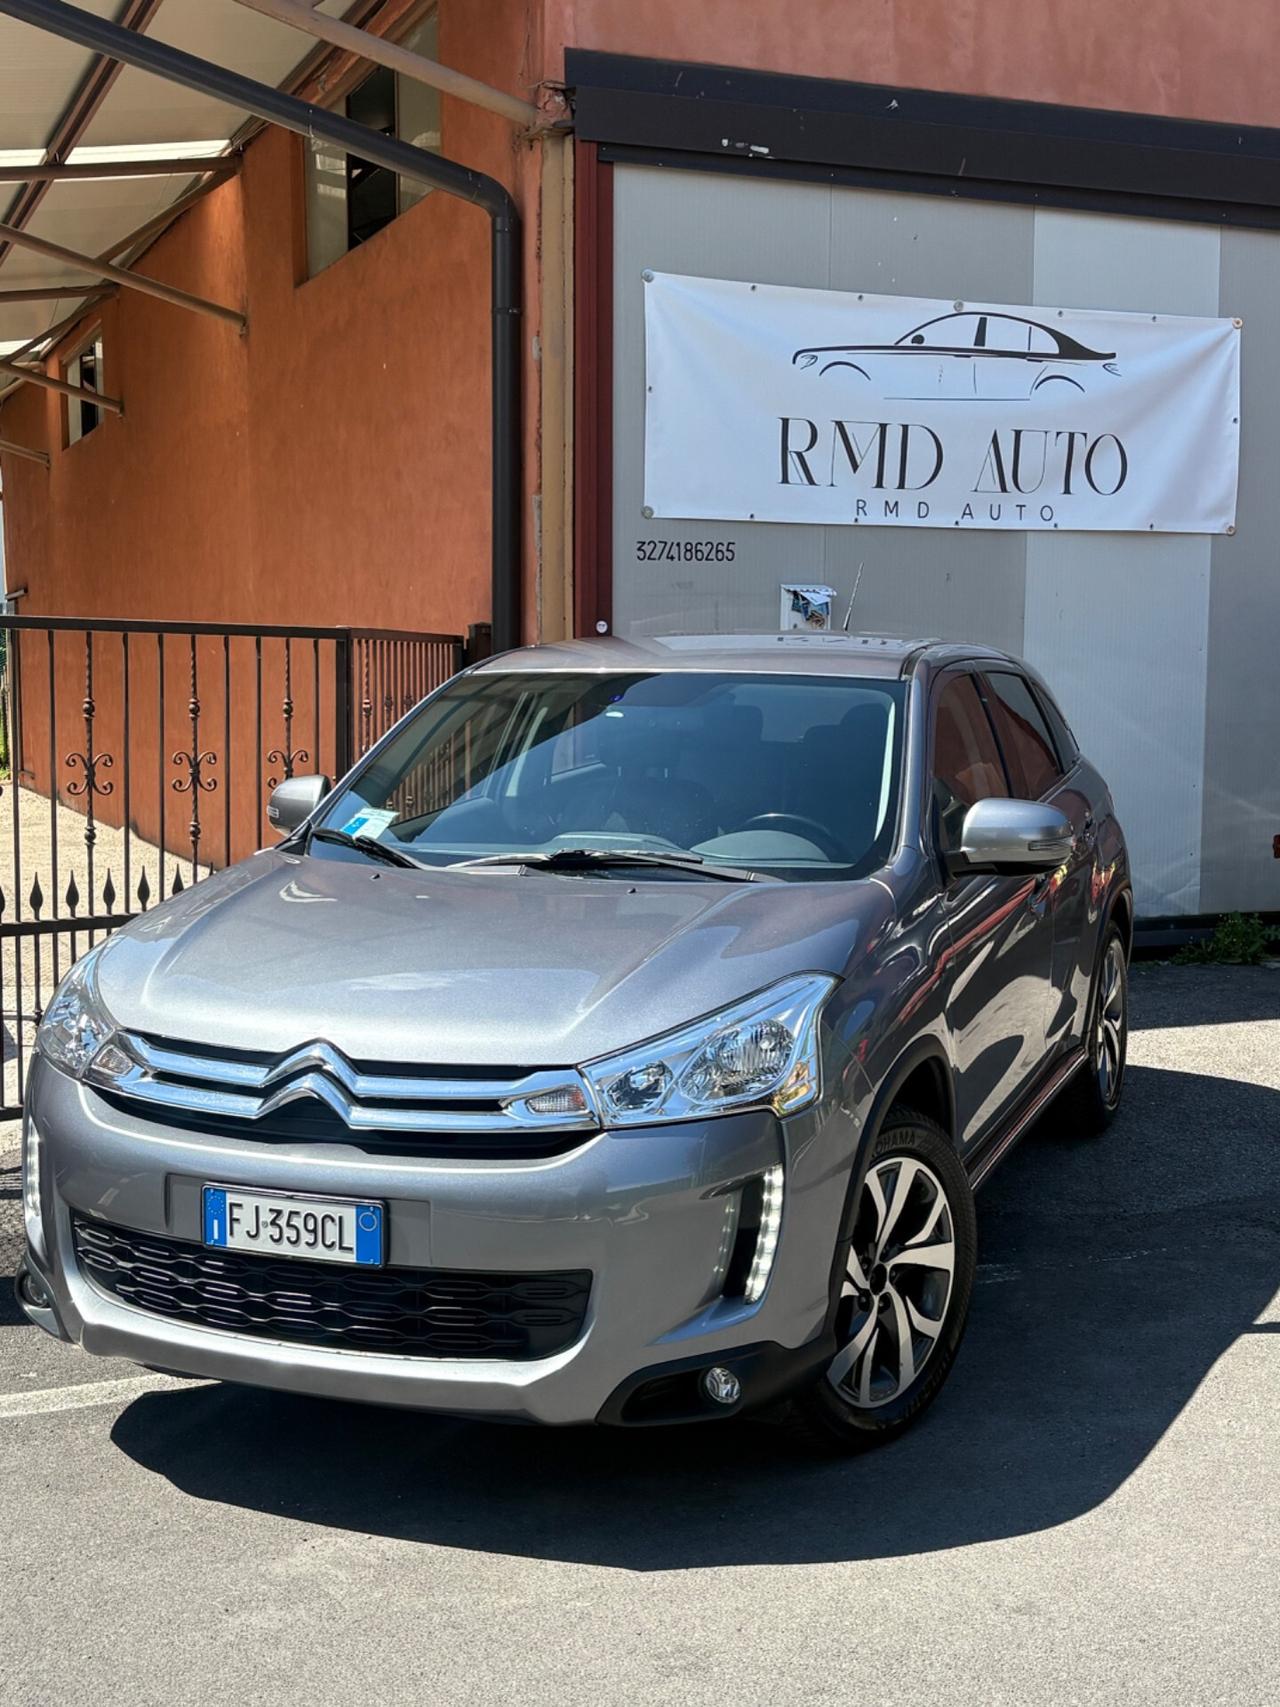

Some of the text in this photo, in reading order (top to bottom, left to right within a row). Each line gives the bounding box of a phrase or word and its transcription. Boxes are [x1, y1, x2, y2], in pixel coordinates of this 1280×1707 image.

[777, 416, 1128, 496] RMD AUTO
[856, 499, 1054, 522] RMD AUTO
[636, 540, 736, 562] 3274186265
[875, 1129, 916, 1153] OHAMA
